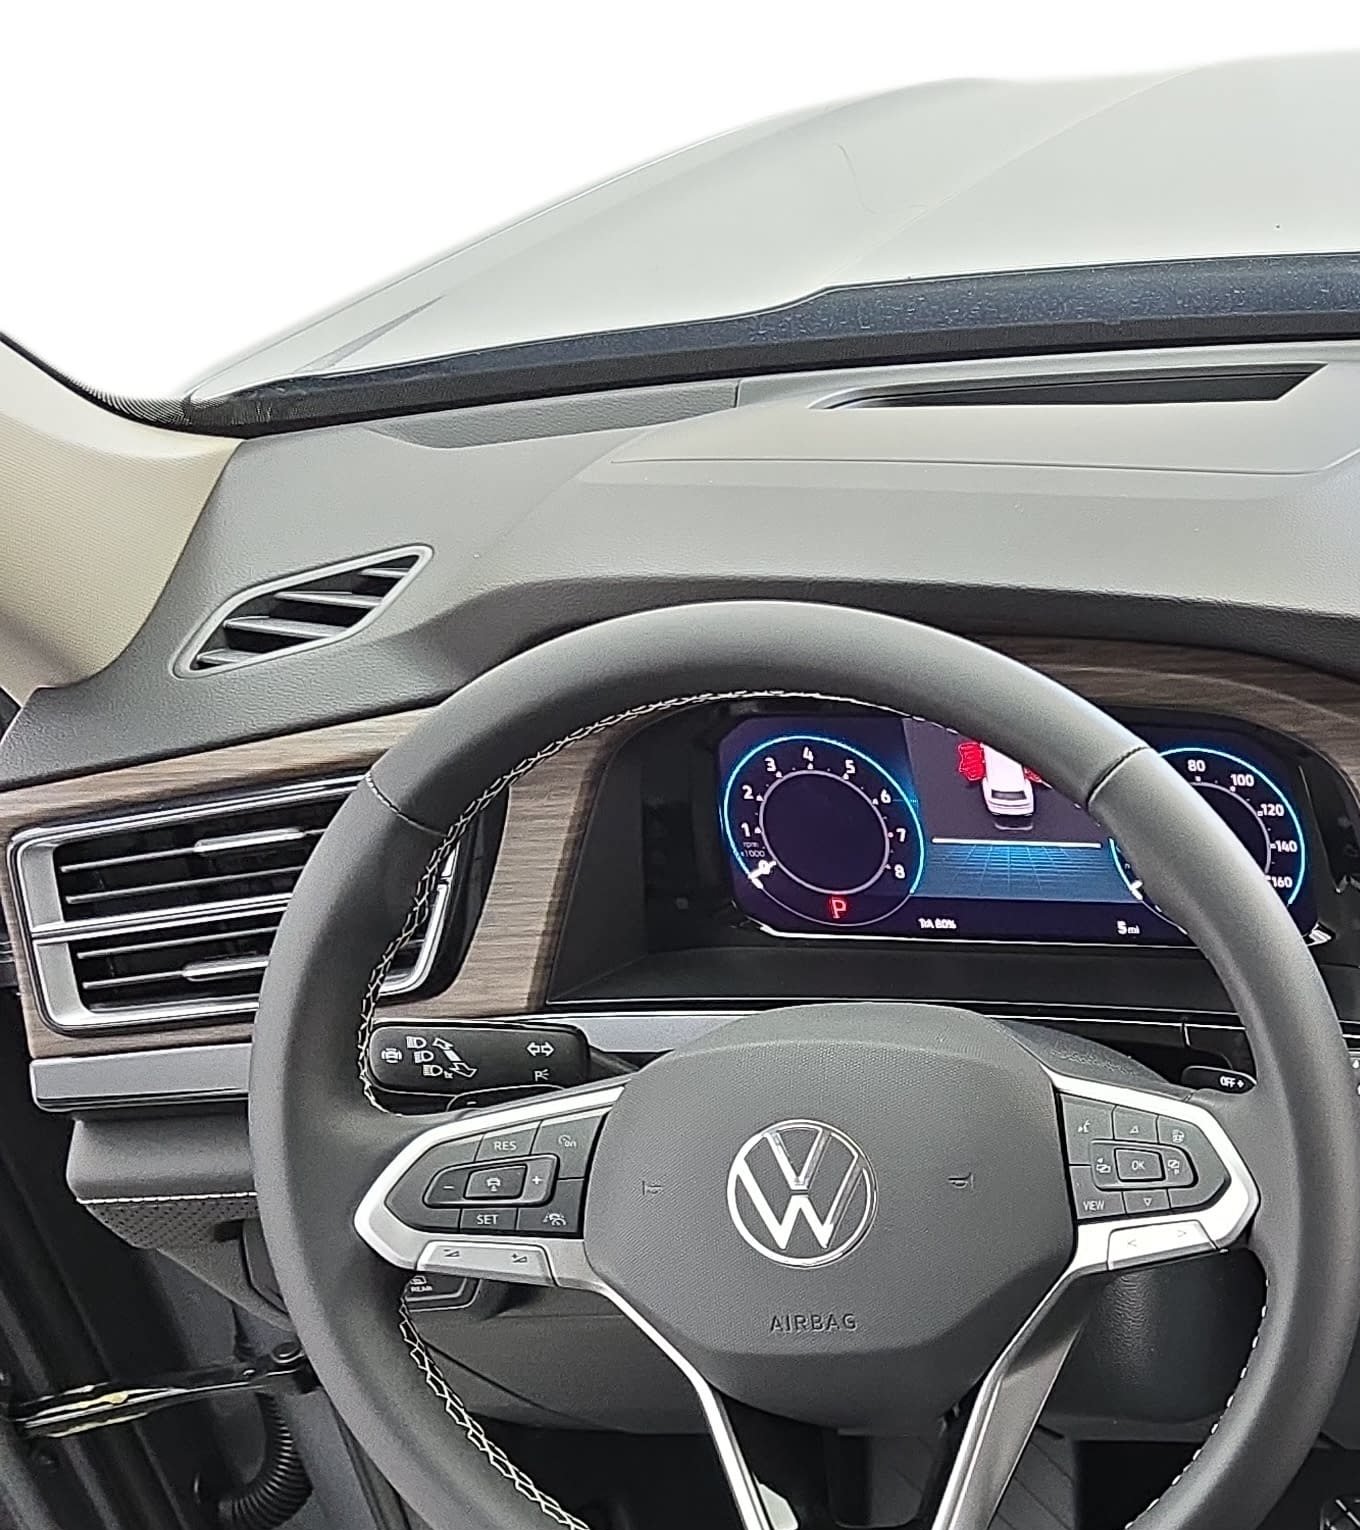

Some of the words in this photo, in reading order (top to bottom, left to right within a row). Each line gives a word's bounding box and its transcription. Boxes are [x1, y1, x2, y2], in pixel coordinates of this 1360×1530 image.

[803, 747, 814, 762] 4
[764, 757, 777, 772] 3
[845, 760, 856, 774] 5
[1188, 760, 1206, 772] 80
[1230, 774, 1255, 787] 100
[742, 785, 754, 800] 2
[880, 790, 892, 804] 6
[1261, 804, 1285, 817] 120
[741, 823, 750, 837] 1
[896, 828, 906, 842] 7
[1276, 840, 1298, 852] 140
[894, 864, 906, 879] 8
[1271, 876, 1293, 889] 160
[831, 899, 847, 919] P
[494, 1141, 517, 1151] RES
[1131, 1160, 1145, 1171] OK
[1083, 1200, 1105, 1211] VIEW
[477, 1215, 498, 1225] SET
[770, 1313, 857, 1332] AIRBAG
